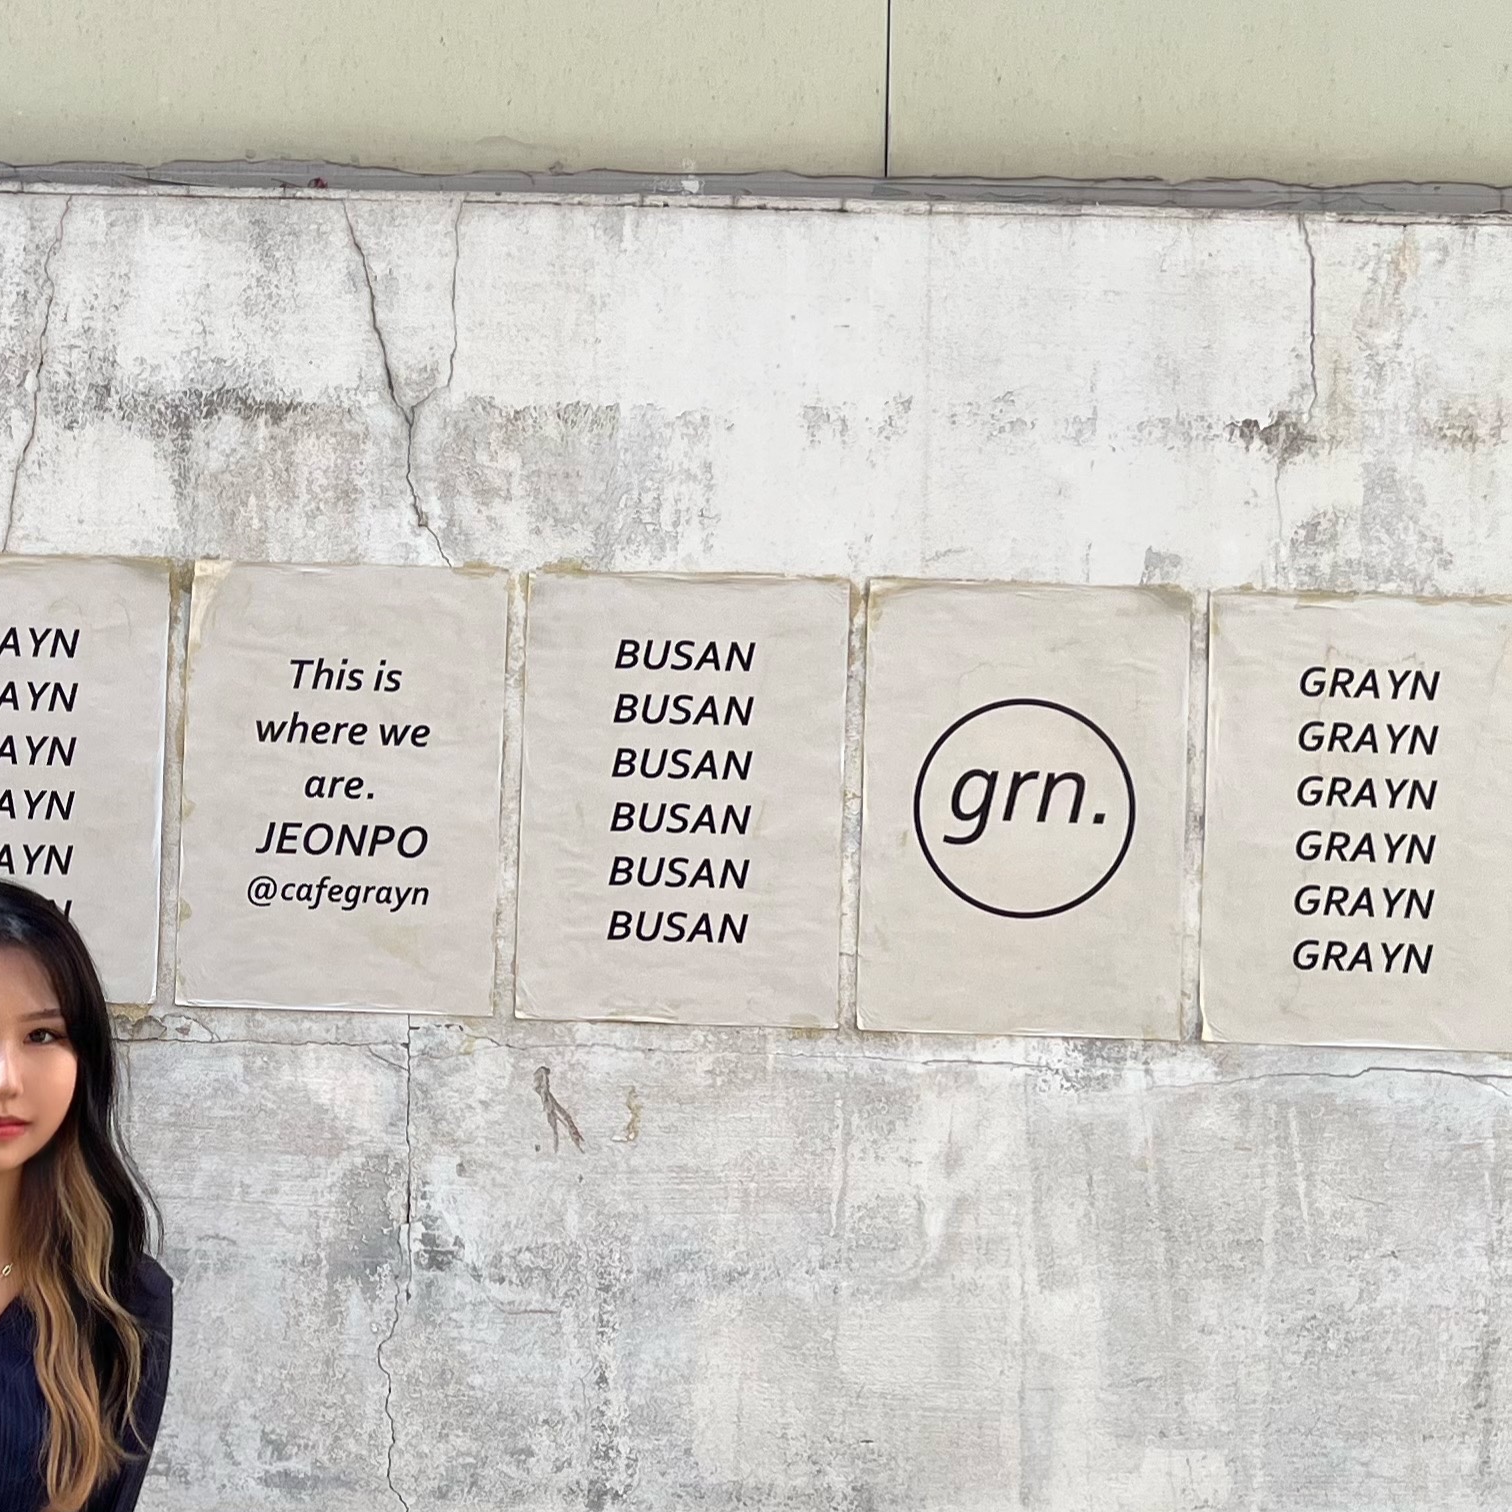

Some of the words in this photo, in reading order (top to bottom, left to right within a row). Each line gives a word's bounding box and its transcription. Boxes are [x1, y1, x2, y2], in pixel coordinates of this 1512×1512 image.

[614, 639, 756, 672] BUSAN
[290, 657, 364, 692] This
[373, 659, 403, 693] is
[1299, 666, 1441, 701] GRAYN
[613, 693, 754, 726] BUSAN
[255, 711, 368, 746] where
[379, 723, 431, 748] we
[1298, 721, 1439, 755] GRAYN
[611, 747, 753, 781] BUSAN
[304, 775, 375, 800] are.
[1297, 775, 1438, 810] GRAYN
[610, 802, 752, 835] BUSAN
[942, 769, 1106, 845] grn.
[255, 821, 428, 859] JEONPO
[1295, 830, 1437, 865] GRAYN
[608, 856, 750, 889] BUSAN
[247, 875, 429, 913] @cafegrayn
[1294, 884, 1435, 920] GRAYN
[607, 910, 749, 944] BUSAN
[1292, 939, 1434, 974] GRAYN
